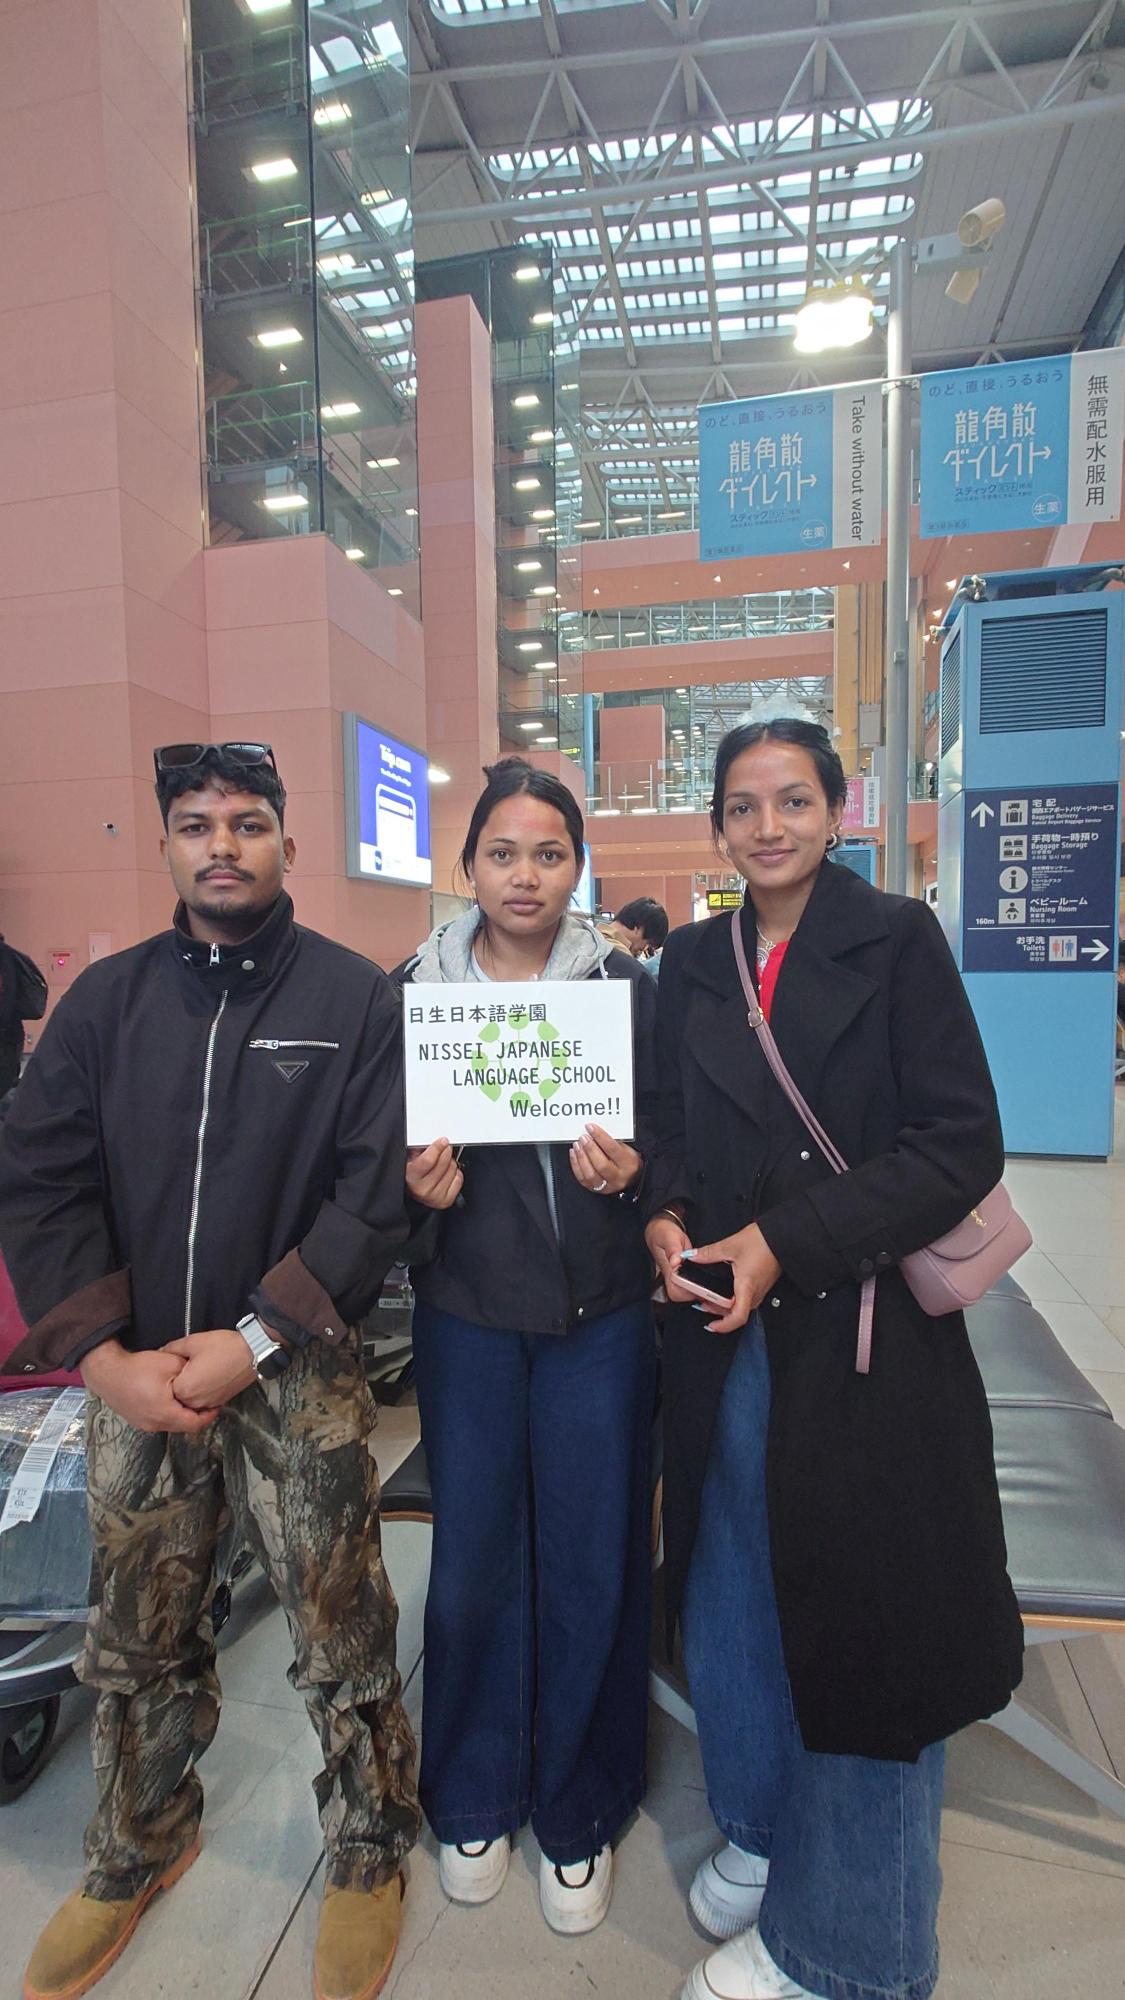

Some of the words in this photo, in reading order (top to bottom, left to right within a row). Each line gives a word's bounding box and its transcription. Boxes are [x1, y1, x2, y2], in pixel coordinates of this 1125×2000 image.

[929, 369, 1063, 398] のど、直接、うるおう
[705, 402, 826, 429] のど、直接、うるおう
[852, 395, 866, 434] Take
[954, 401, 1037, 444] 龍角散
[729, 431, 803, 474] 龍角散
[1085, 374, 1109, 507] 無需配水服用
[852, 437, 865, 494] without
[851, 498, 864, 540] water
[1031, 843, 1060, 851] Baggage
[1029, 906, 1056, 914] Nursing
[1030, 896, 1088, 906] ベビールーム
[1016, 936, 1045, 945] お手洗
[409, 1003, 547, 1024] 日生日本語学園
[419, 1043, 483, 1061] NISSEI
[496, 1040, 582, 1059] JAPANESE
[453, 1067, 540, 1086] LANGUAGE
[551, 1066, 616, 1084] SCHOOL
[510, 1097, 621, 1117] Welcome!!
